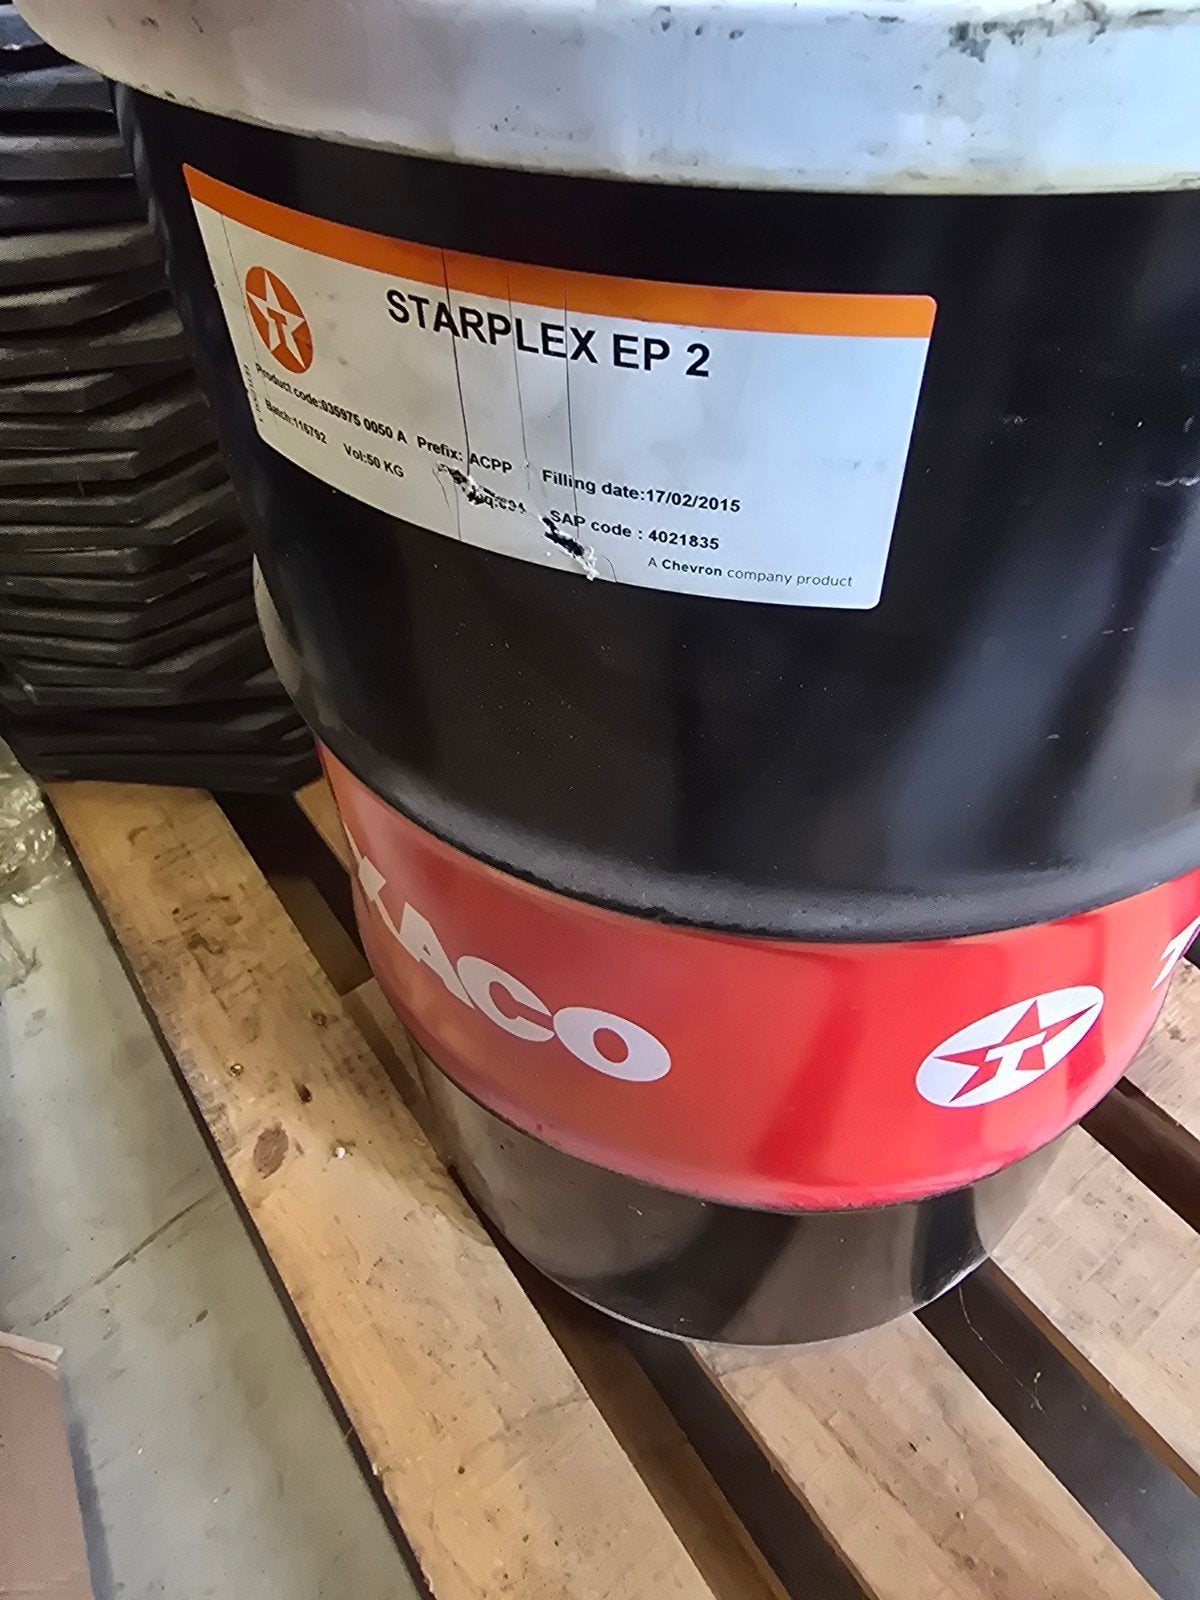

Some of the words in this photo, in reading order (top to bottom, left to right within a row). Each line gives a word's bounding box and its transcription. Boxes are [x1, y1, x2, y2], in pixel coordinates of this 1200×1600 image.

[386, 288, 599, 365] STARPLEX
[612, 333, 670, 371] EP
[685, 343, 711, 378] 2
[255, 362, 292, 394] Product
[293, 387, 361, 427] code:035975
[363, 417, 393, 439] 0050
[397, 430, 408, 444] A
[416, 435, 463, 462] Prefix:
[469, 452, 513, 474] ACPP
[264, 398, 328, 444] Batch:116792
[343, 442, 381, 469] Vol:50
[383, 460, 405, 478] KG
[542, 469, 597, 495] Filling
[601, 481, 742, 513] date:17/02/2015
[550, 509, 587, 528] SAP
[591, 519, 632, 539] code
[648, 529, 720, 551] 4021835
[647, 556, 658, 568] A
[661, 558, 723, 577] Chevron
[727, 567, 793, 585] company
[796, 573, 854, 588] product
